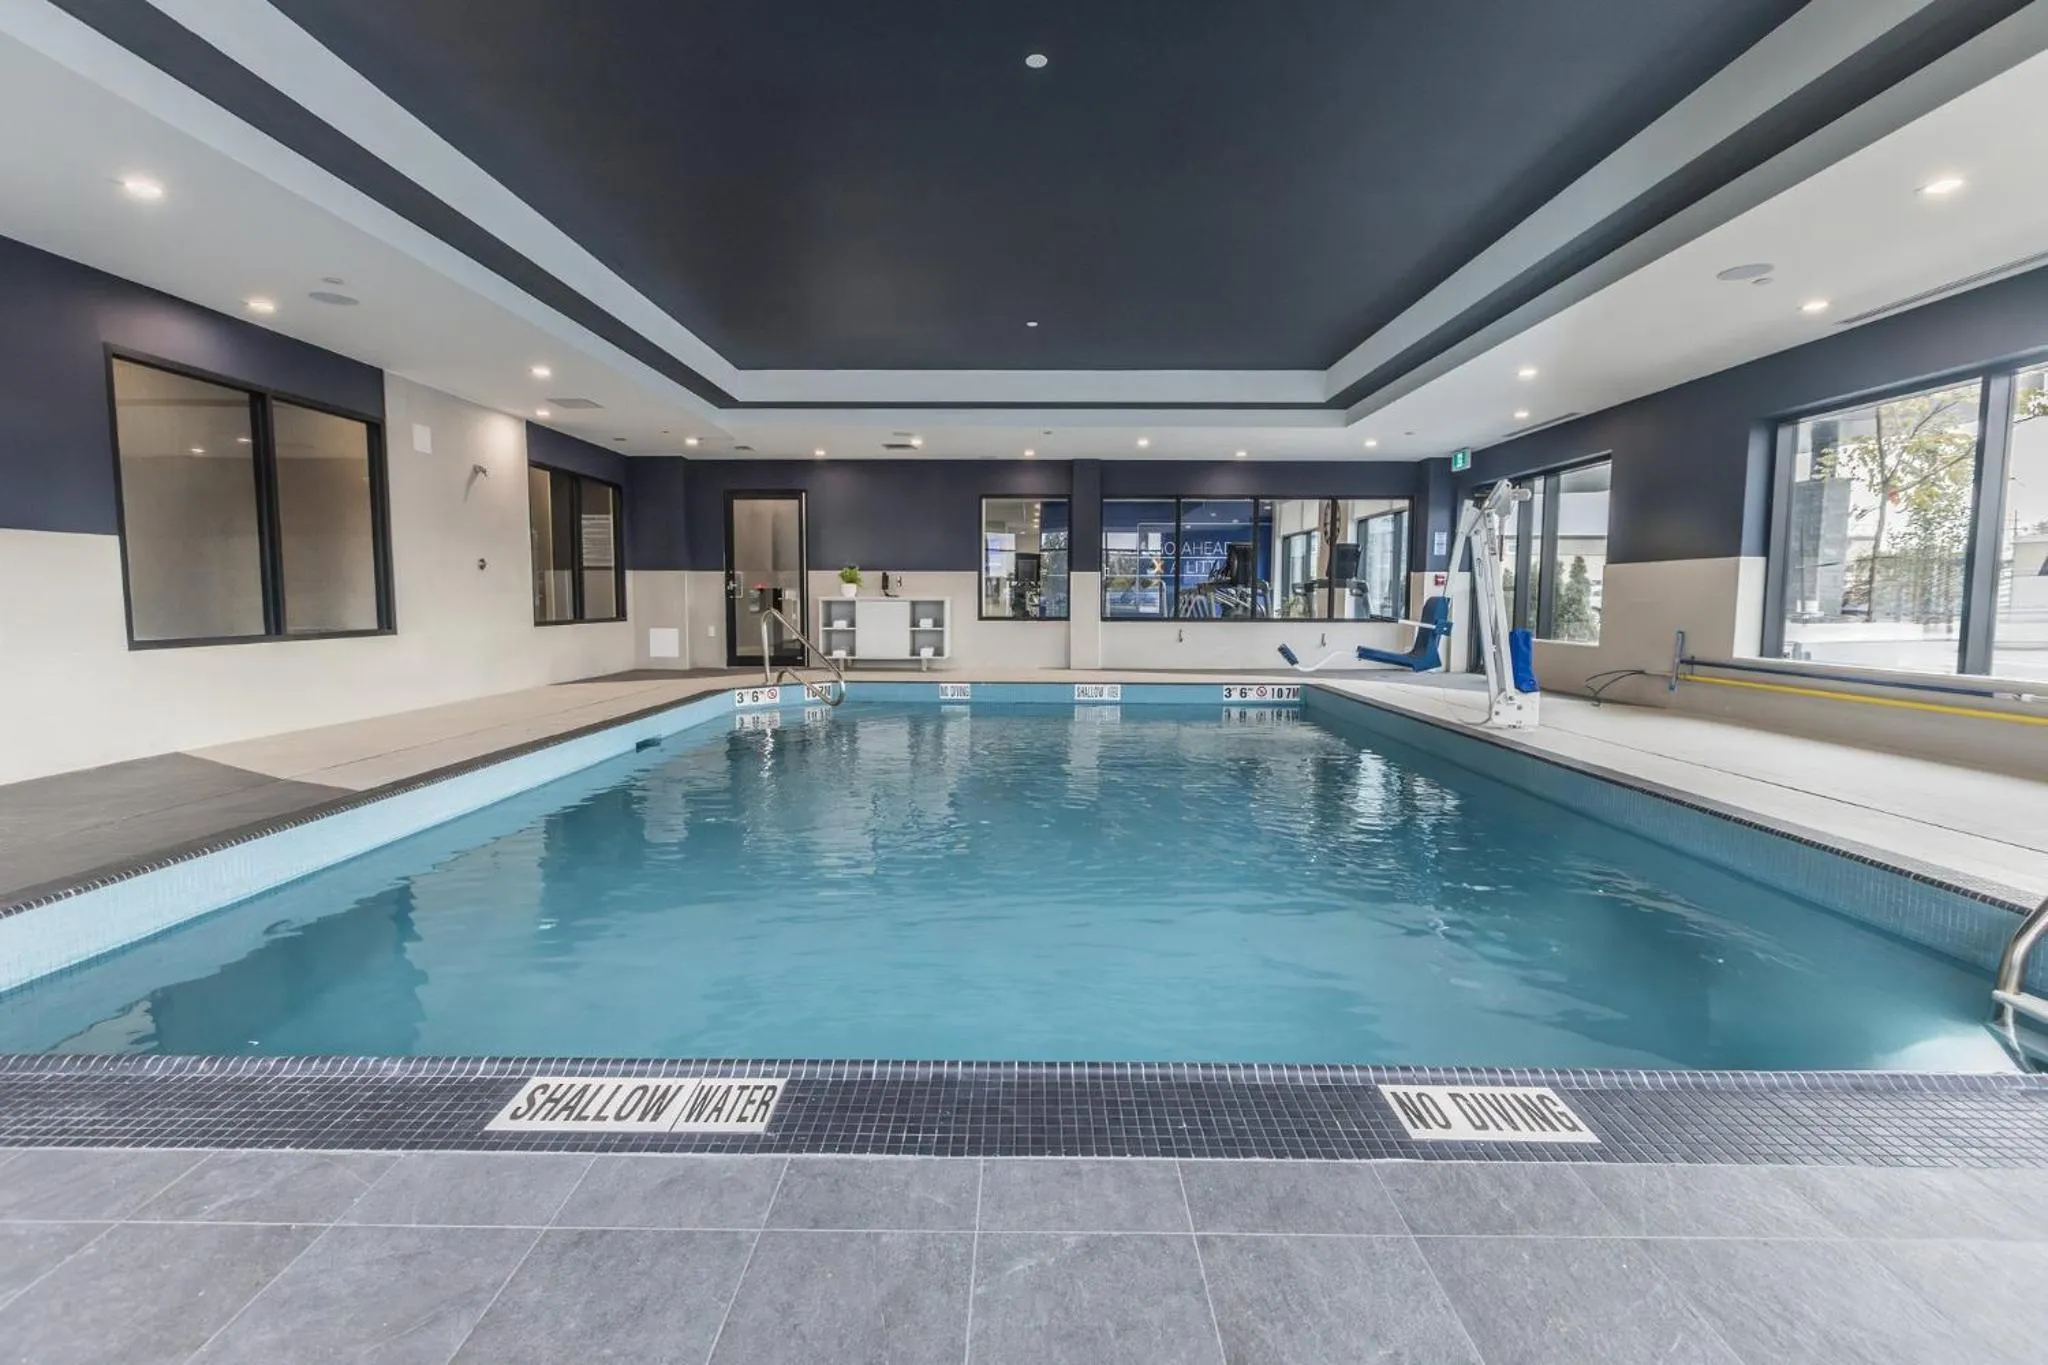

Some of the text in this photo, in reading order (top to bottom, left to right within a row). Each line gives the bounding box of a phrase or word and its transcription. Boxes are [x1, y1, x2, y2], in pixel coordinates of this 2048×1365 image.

[1186, 560, 1220, 574] LITT
[509, 1083, 778, 1123] SHALLOW WATER
[1390, 1091, 1584, 1132] NO DIVING
